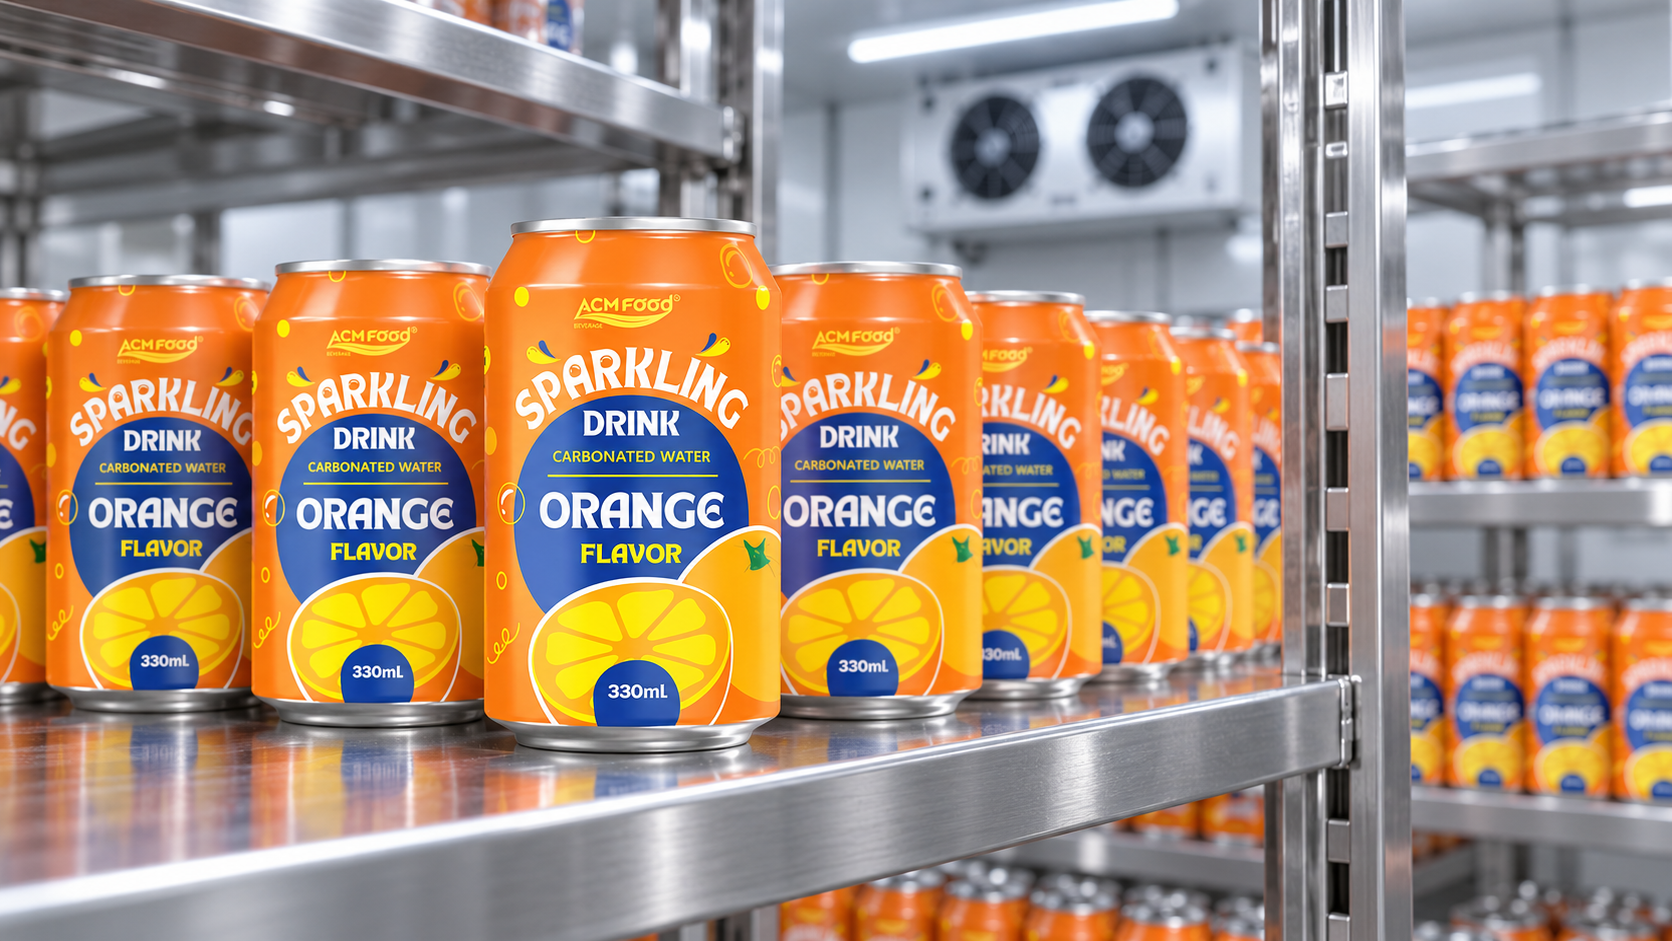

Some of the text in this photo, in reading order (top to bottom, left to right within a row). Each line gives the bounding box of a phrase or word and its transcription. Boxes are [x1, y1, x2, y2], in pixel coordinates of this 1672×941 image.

[574, 297, 619, 320] ACM
[117, 338, 153, 357] ACM
[326, 329, 364, 349] ACM
[812, 330, 849, 349] ACM
[515, 346, 749, 430] SPARKLING
[70, 377, 252, 447] SPARKLING
[276, 371, 477, 444] SPARKLING
[781, 371, 956, 442] PARKLING
[583, 409, 680, 436] DRINK
[124, 429, 201, 451] DRINK
[333, 426, 415, 450] DRINK
[820, 425, 899, 448] DRINK
[552, 450, 711, 463] CARBONATED WATER
[794, 459, 925, 471] CARBONATED WATER
[99, 462, 226, 473] CARBONATED WATER
[308, 461, 441, 473] CARBONATED WATER
[88, 497, 238, 529] ORANGE
[296, 497, 454, 530] ORANGE
[539, 491, 725, 529] ORANGE
[783, 494, 936, 527] ORANGE
[121, 540, 203, 557] FLAVOR
[330, 542, 417, 560] FLAVOR
[581, 543, 681, 564] FLAVOR
[817, 539, 901, 557] FLAVOR
[141, 654, 190, 667] 330mL
[982, 647, 1022, 661] 30mL
[352, 665, 404, 679] 330mL
[838, 659, 889, 673] 330mL
[608, 684, 668, 699] 330mL
